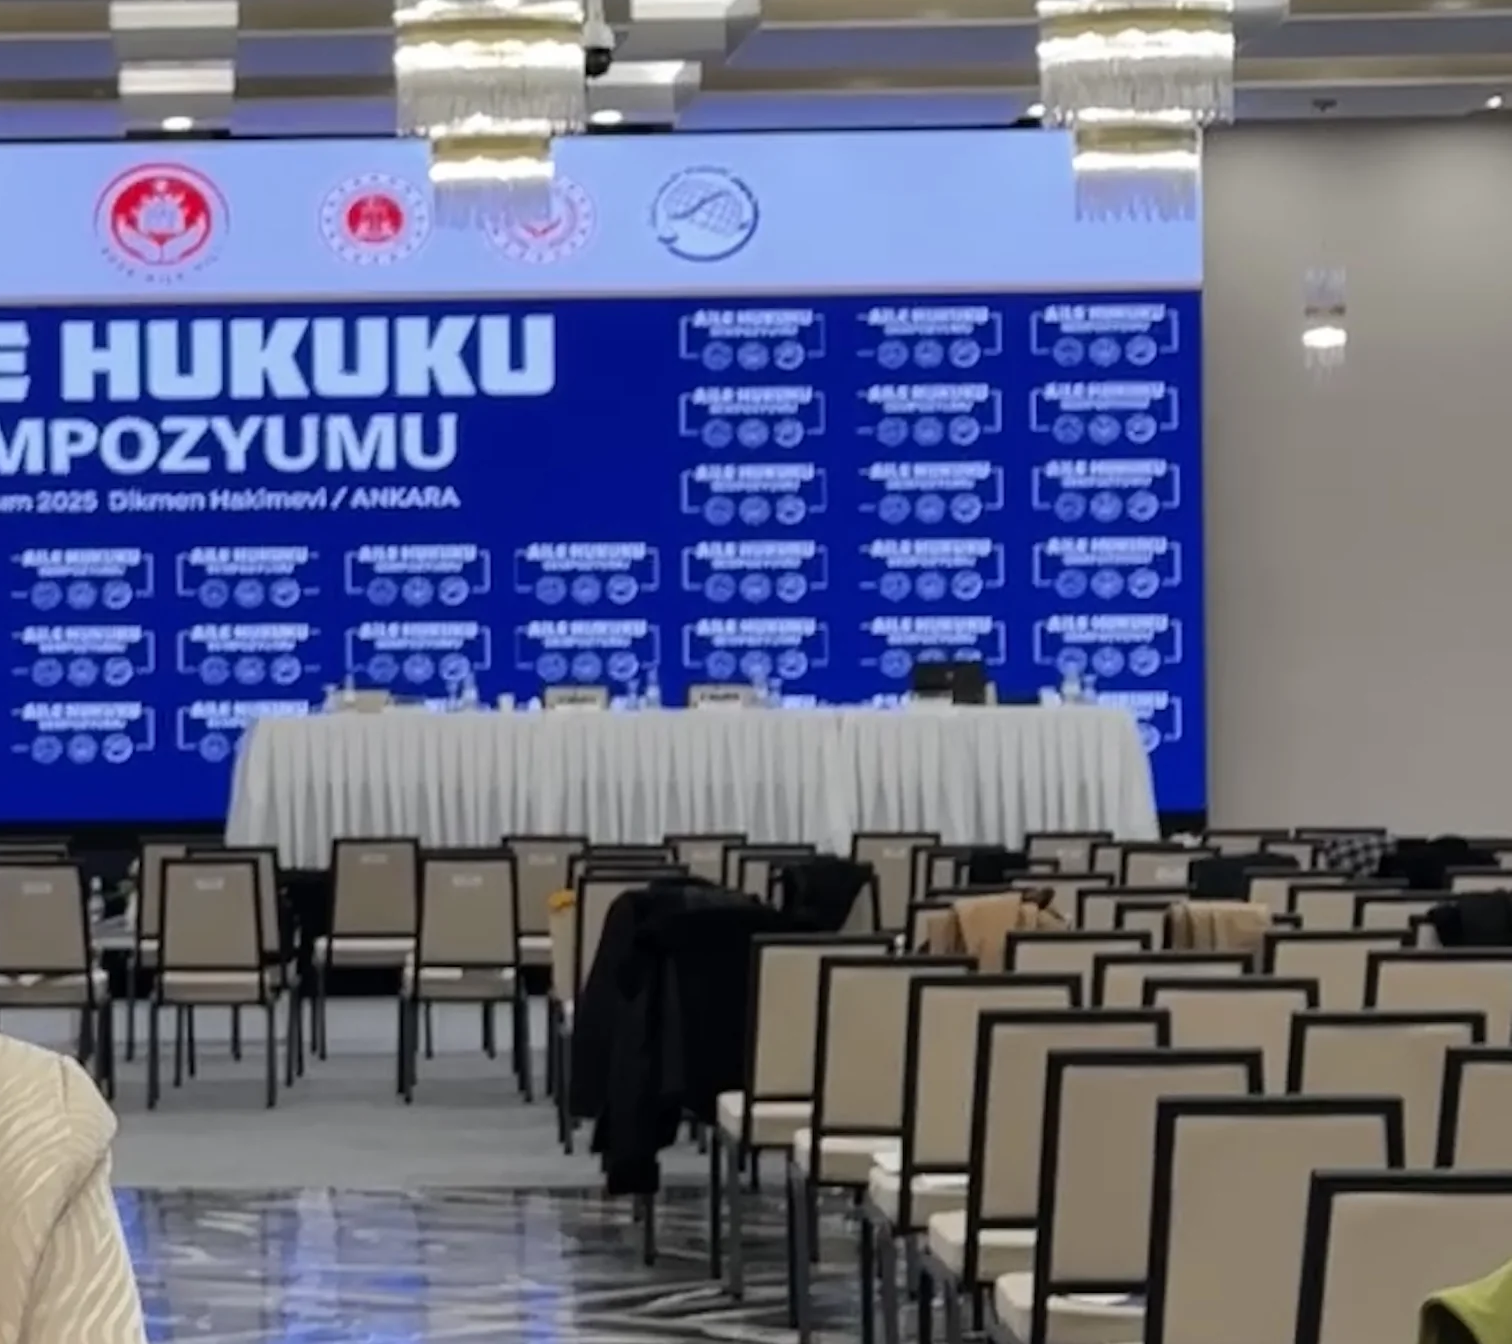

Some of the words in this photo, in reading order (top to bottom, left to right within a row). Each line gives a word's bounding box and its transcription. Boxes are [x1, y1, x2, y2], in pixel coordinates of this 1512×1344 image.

[61, 314, 556, 402] HUKUKU
[36, 490, 99, 513] 2025
[108, 488, 206, 512] Dikmen
[330, 486, 348, 510] /
[350, 485, 461, 509] ANKARA
